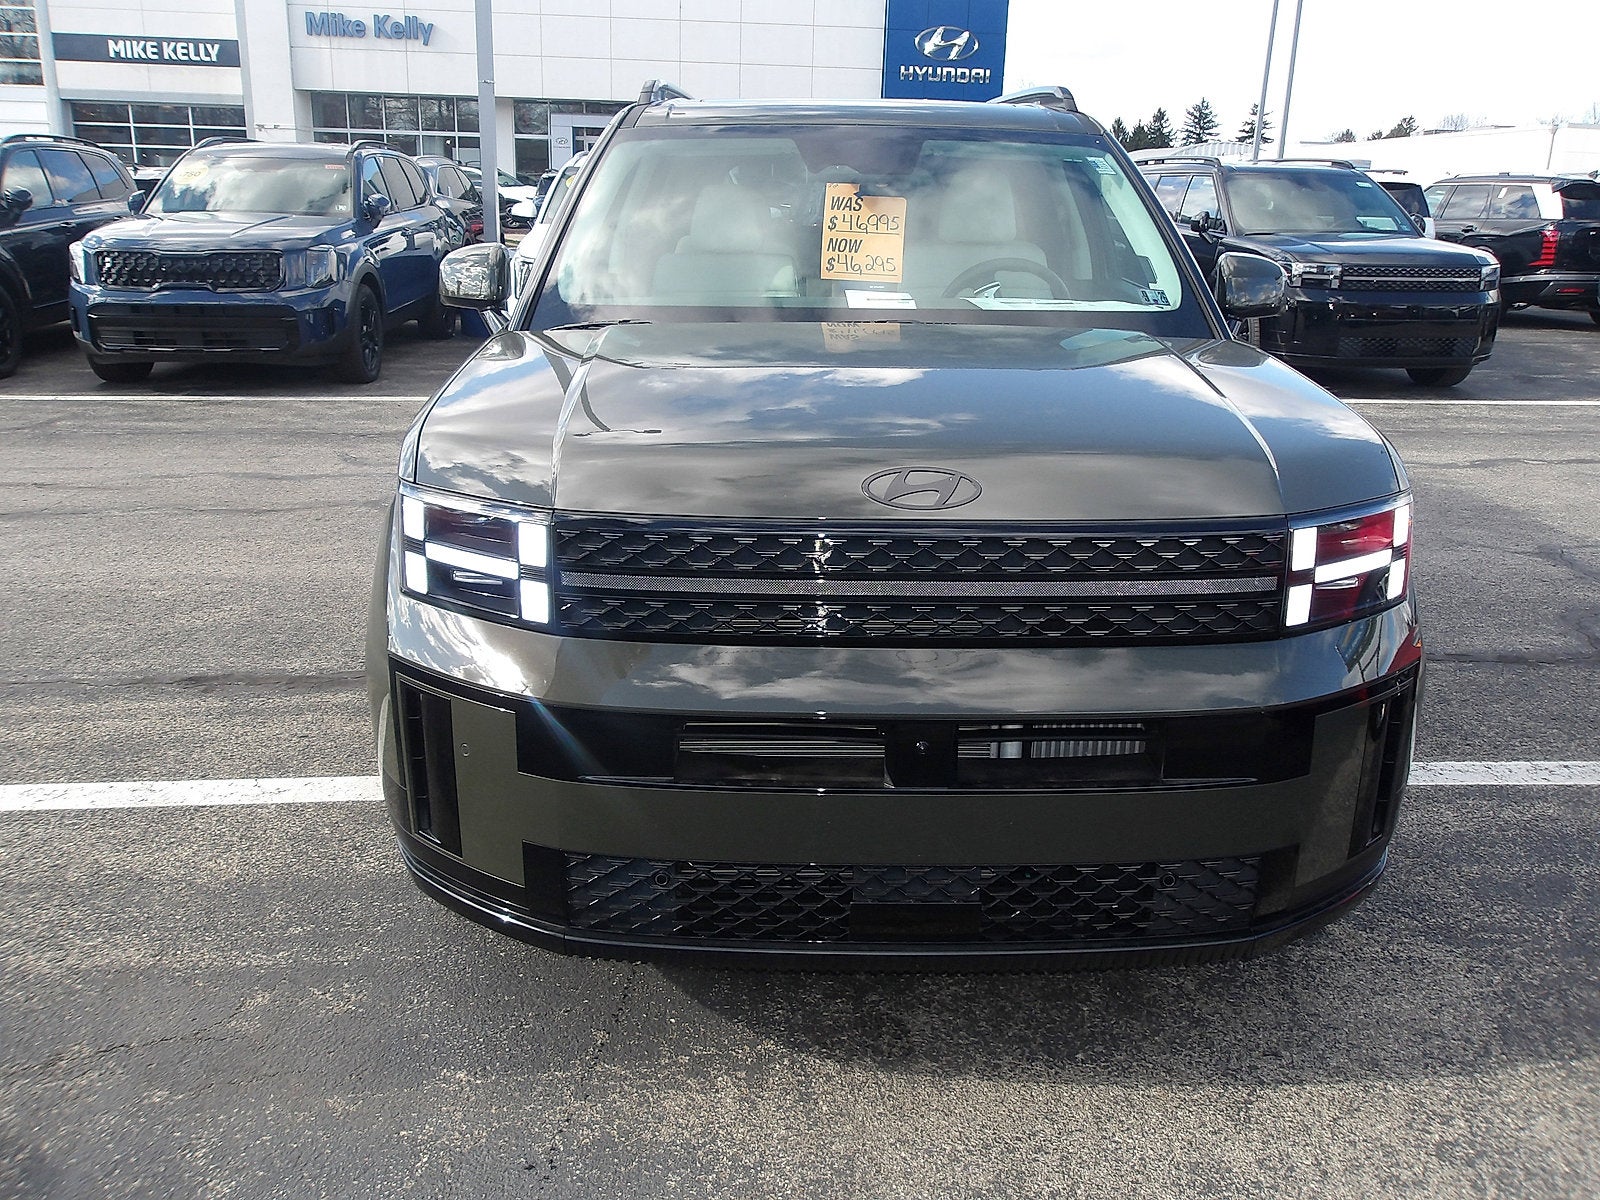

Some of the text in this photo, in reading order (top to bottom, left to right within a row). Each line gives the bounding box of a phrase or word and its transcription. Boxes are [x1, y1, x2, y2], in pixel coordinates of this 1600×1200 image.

[305, 11, 434, 46] Mike Kelly
[107, 39, 219, 62] MIKE KELLY
[899, 65, 991, 84] HYUNDAI
[831, 196, 863, 212] WAS
[827, 238, 863, 253] NOW
